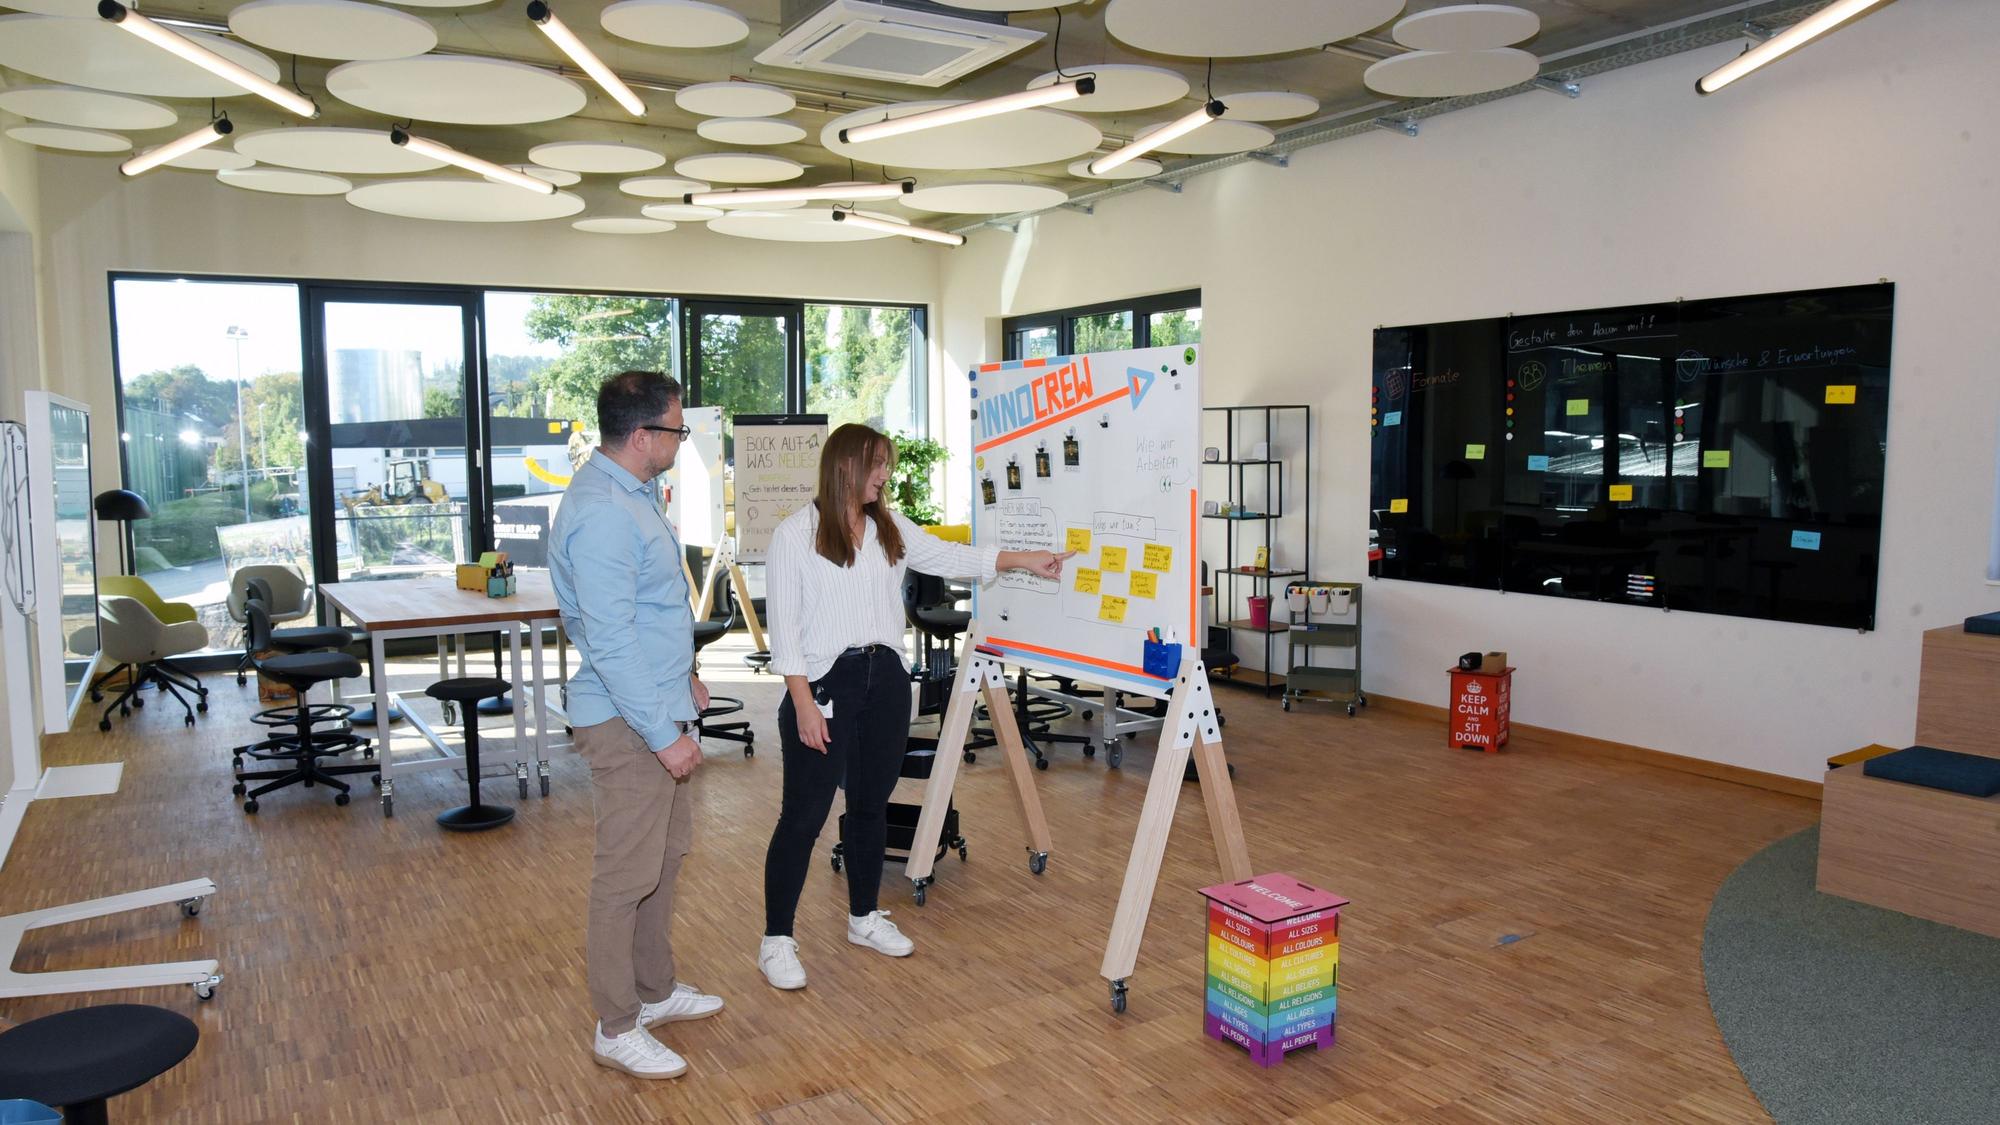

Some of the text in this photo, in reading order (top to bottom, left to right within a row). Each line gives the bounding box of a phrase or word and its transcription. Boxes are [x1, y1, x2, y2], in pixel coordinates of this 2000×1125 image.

[1509, 327, 1556, 349] Gestalte
[1567, 323, 1583, 337] den
[1593, 322, 1618, 336] Raum
[1561, 358, 1613, 375] Themen
[1700, 352, 1748, 372] Wünsche
[1757, 350, 1770, 367] &
[1412, 368, 1460, 388] Formate
[979, 356, 1094, 439] INNOCREW
[746, 436, 804, 451] BOCK AUF
[1136, 435, 1176, 453] Wie wir
[747, 452, 817, 469] WAS NEUES
[1136, 455, 1178, 472] Arbeiten
[1461, 694, 1487, 704] KEEP
[1458, 704, 1489, 716] CALM
[1465, 722, 1480, 732] SIT
[1456, 732, 1489, 744] DOWN
[1248, 883, 1303, 909] WELCOME
[1225, 918, 1251, 936] ALL SIZES
[1288, 924, 1319, 939] ALL SIZES
[1219, 943, 1228, 953] ALL
[1220, 930, 1255, 952] ALL COLOURS
[1282, 937, 1323, 955] ALL COLOURS
[1281, 958, 1293, 968] ALL
[1221, 971, 1230, 981] ALL
[1218, 983, 1255, 1008] ALL RELIGIONS
[1283, 985, 1294, 995] ALL
[1224, 1000, 1249, 1018] ALL AGES
[1279, 991, 1323, 1011] ALL RELIGIONS
[1222, 1012, 1249, 1032] ALL TYPES
[1286, 1007, 1315, 1023] ALL AGES
[1220, 1024, 1250, 1047] ALL PEOPLE
[1284, 1020, 1316, 1036] ALL TYPES
[1282, 1032, 1318, 1050] ALL PEOPLE
